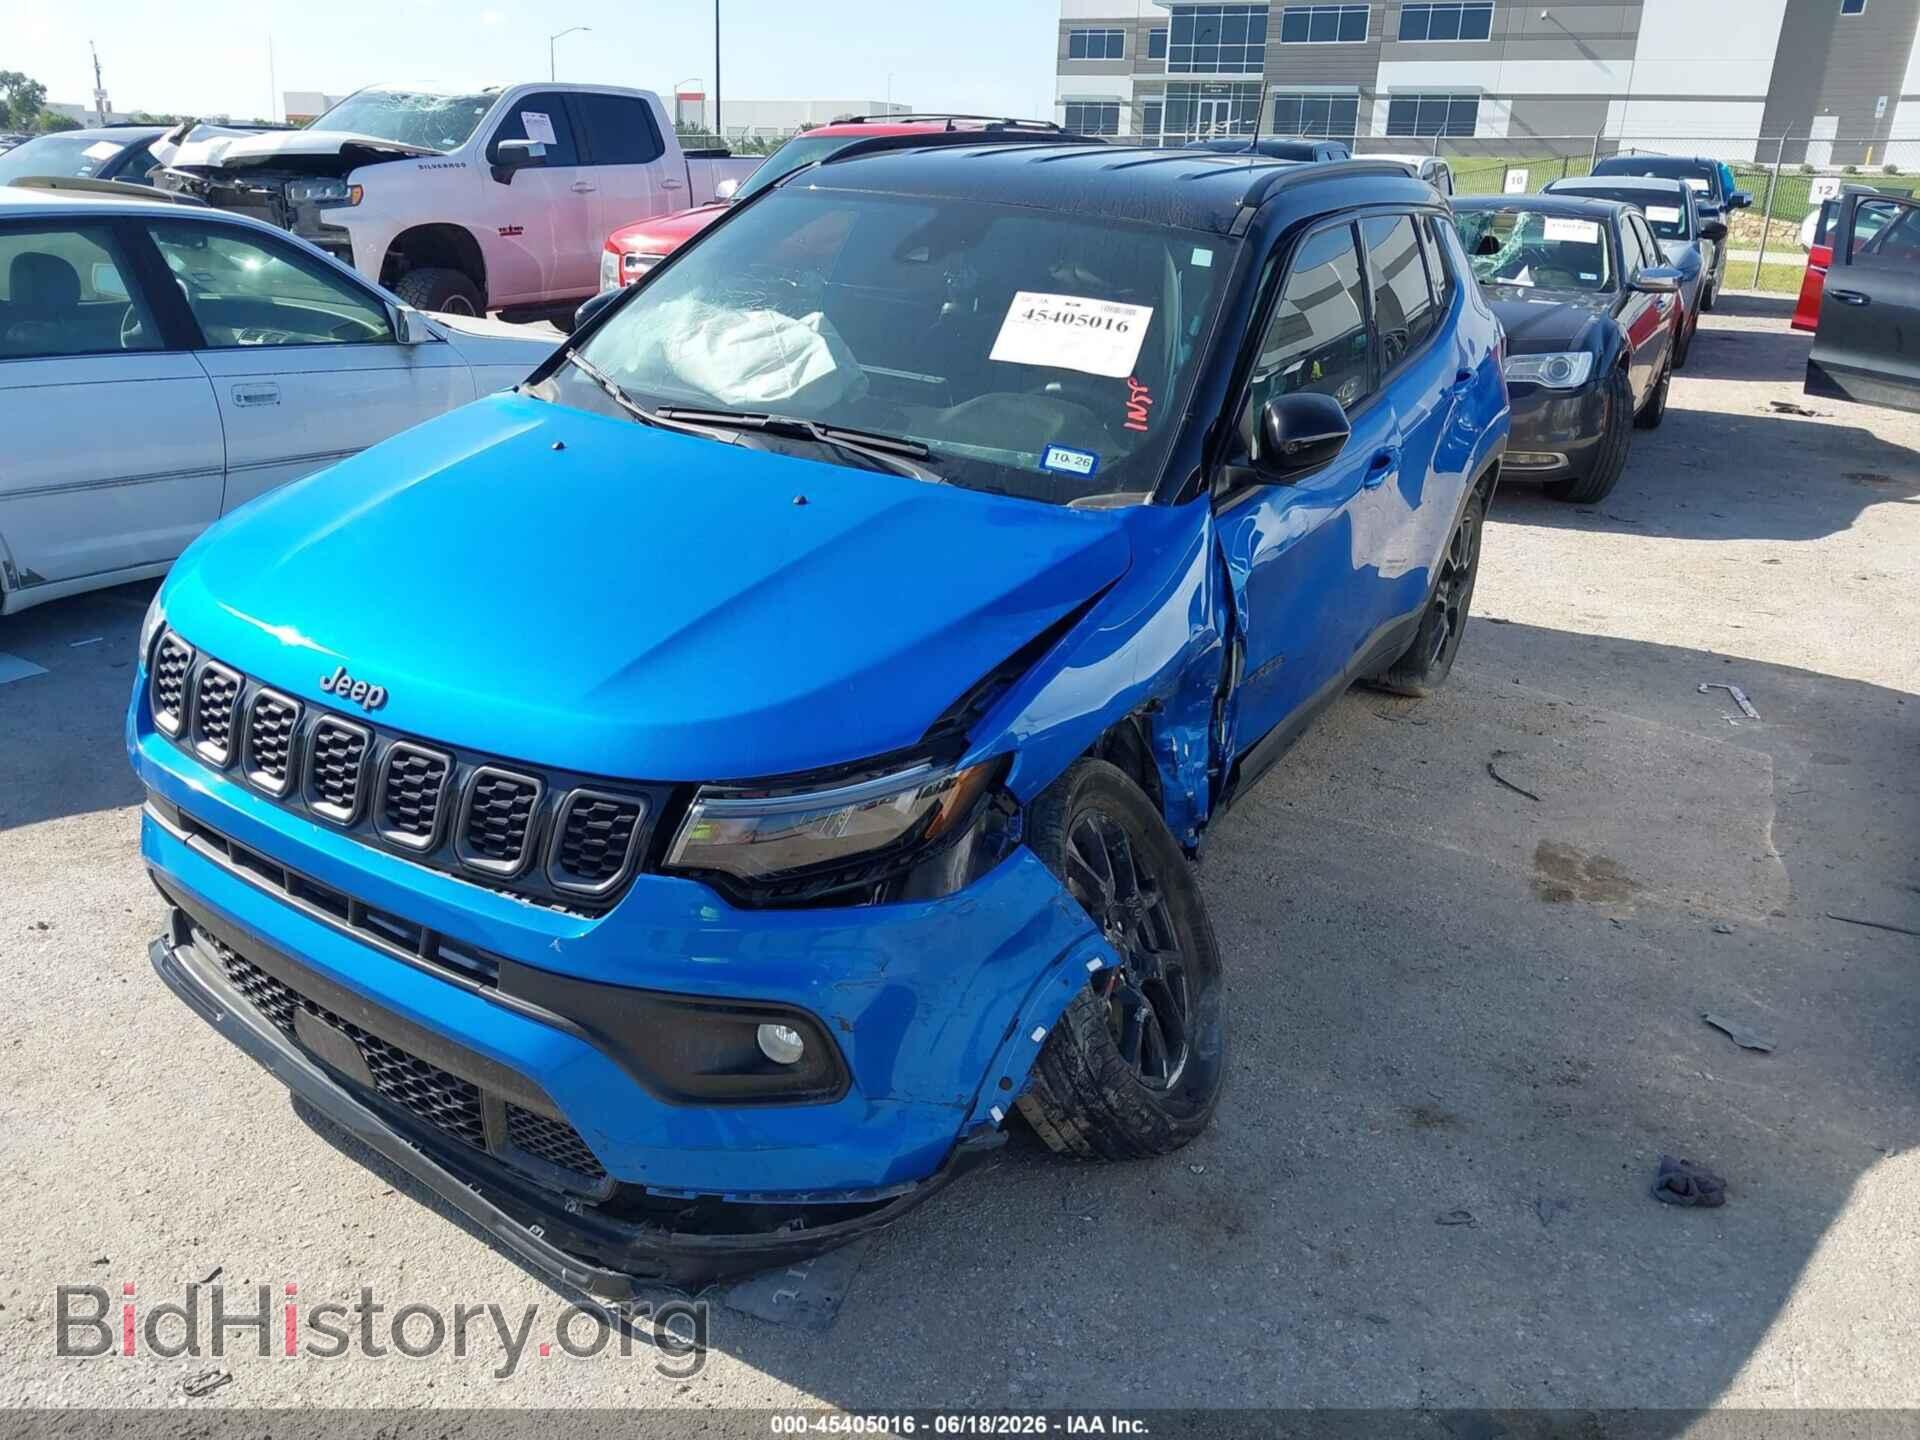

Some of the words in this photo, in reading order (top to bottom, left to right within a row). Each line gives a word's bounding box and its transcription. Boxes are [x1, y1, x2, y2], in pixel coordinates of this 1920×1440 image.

[1511, 175, 1524, 185] 10
[1818, 185, 1833, 195] 12
[1022, 308, 1129, 333] 45405016
[1074, 456, 1090, 467] 26
[320, 666, 386, 711] Jeep
